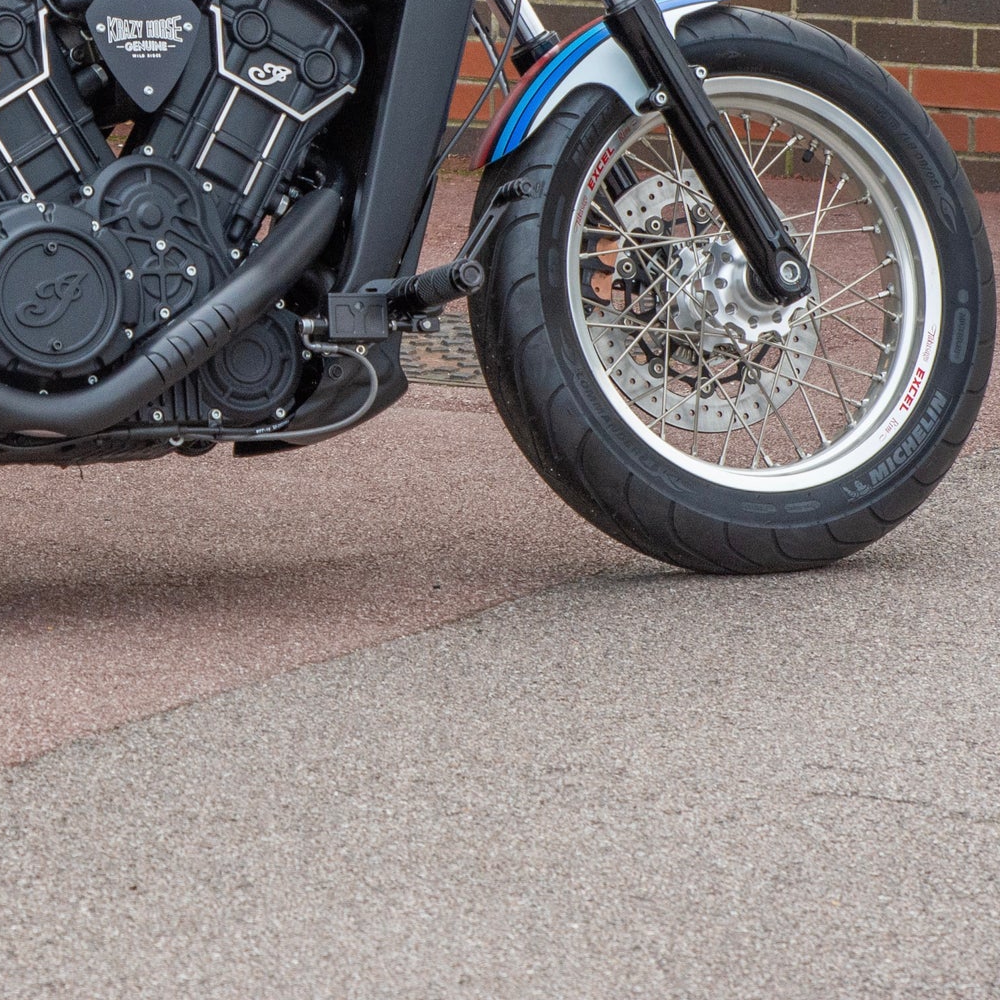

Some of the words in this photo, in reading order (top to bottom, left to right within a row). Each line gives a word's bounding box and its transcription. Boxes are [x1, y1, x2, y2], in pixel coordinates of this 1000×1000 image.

[106, 15, 143, 44] KRAZY
[145, 14, 183, 43] HORSE
[124, 40, 168, 52] GENUINE
[587, 146, 615, 191] EXCEL
[899, 366, 926, 413] EXCEL
[867, 390, 947, 486] MICHELIN
[885, 416, 899, 433] Rim
